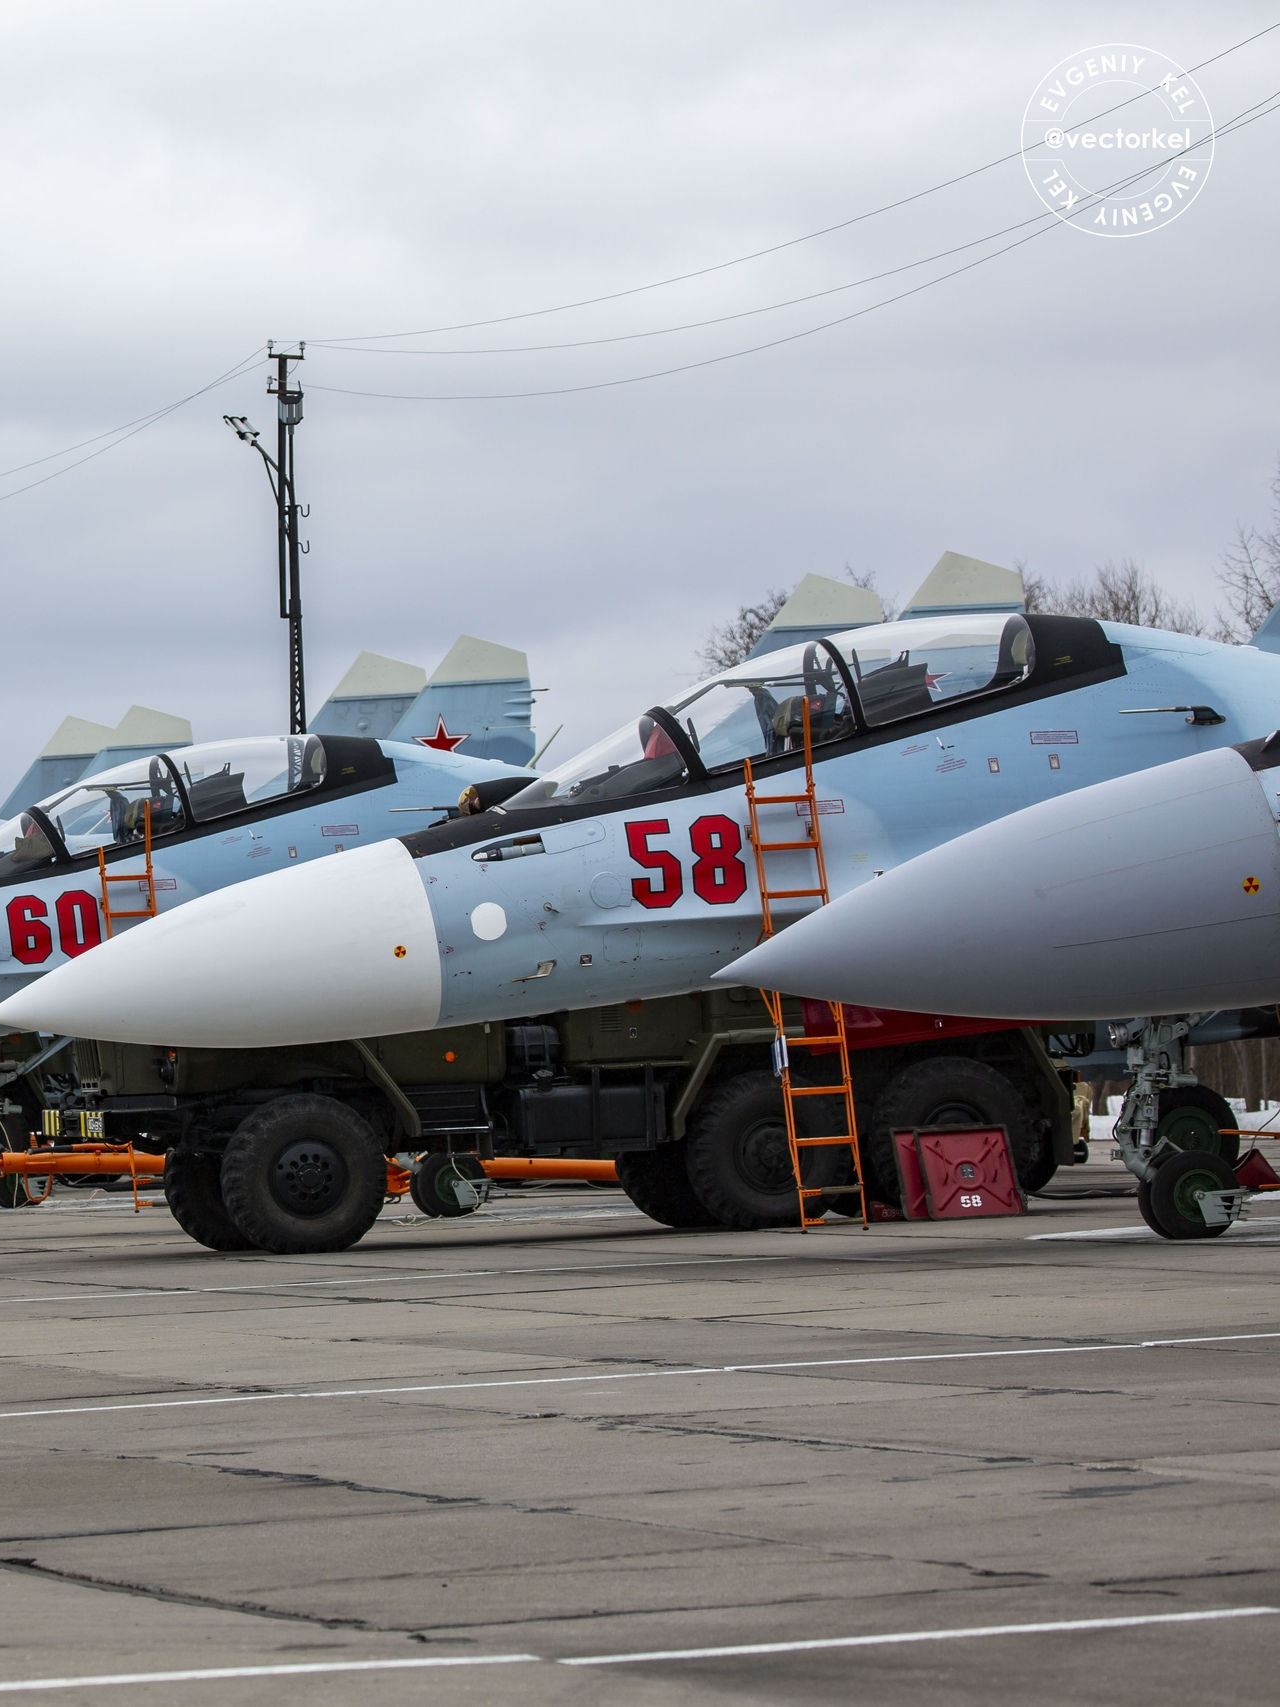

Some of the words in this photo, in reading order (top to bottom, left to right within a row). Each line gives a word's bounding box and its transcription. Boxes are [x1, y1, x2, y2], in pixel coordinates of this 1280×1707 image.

[624, 814, 747, 909] 58
[6, 890, 102, 965] 60
[960, 1195, 982, 1208] 58
